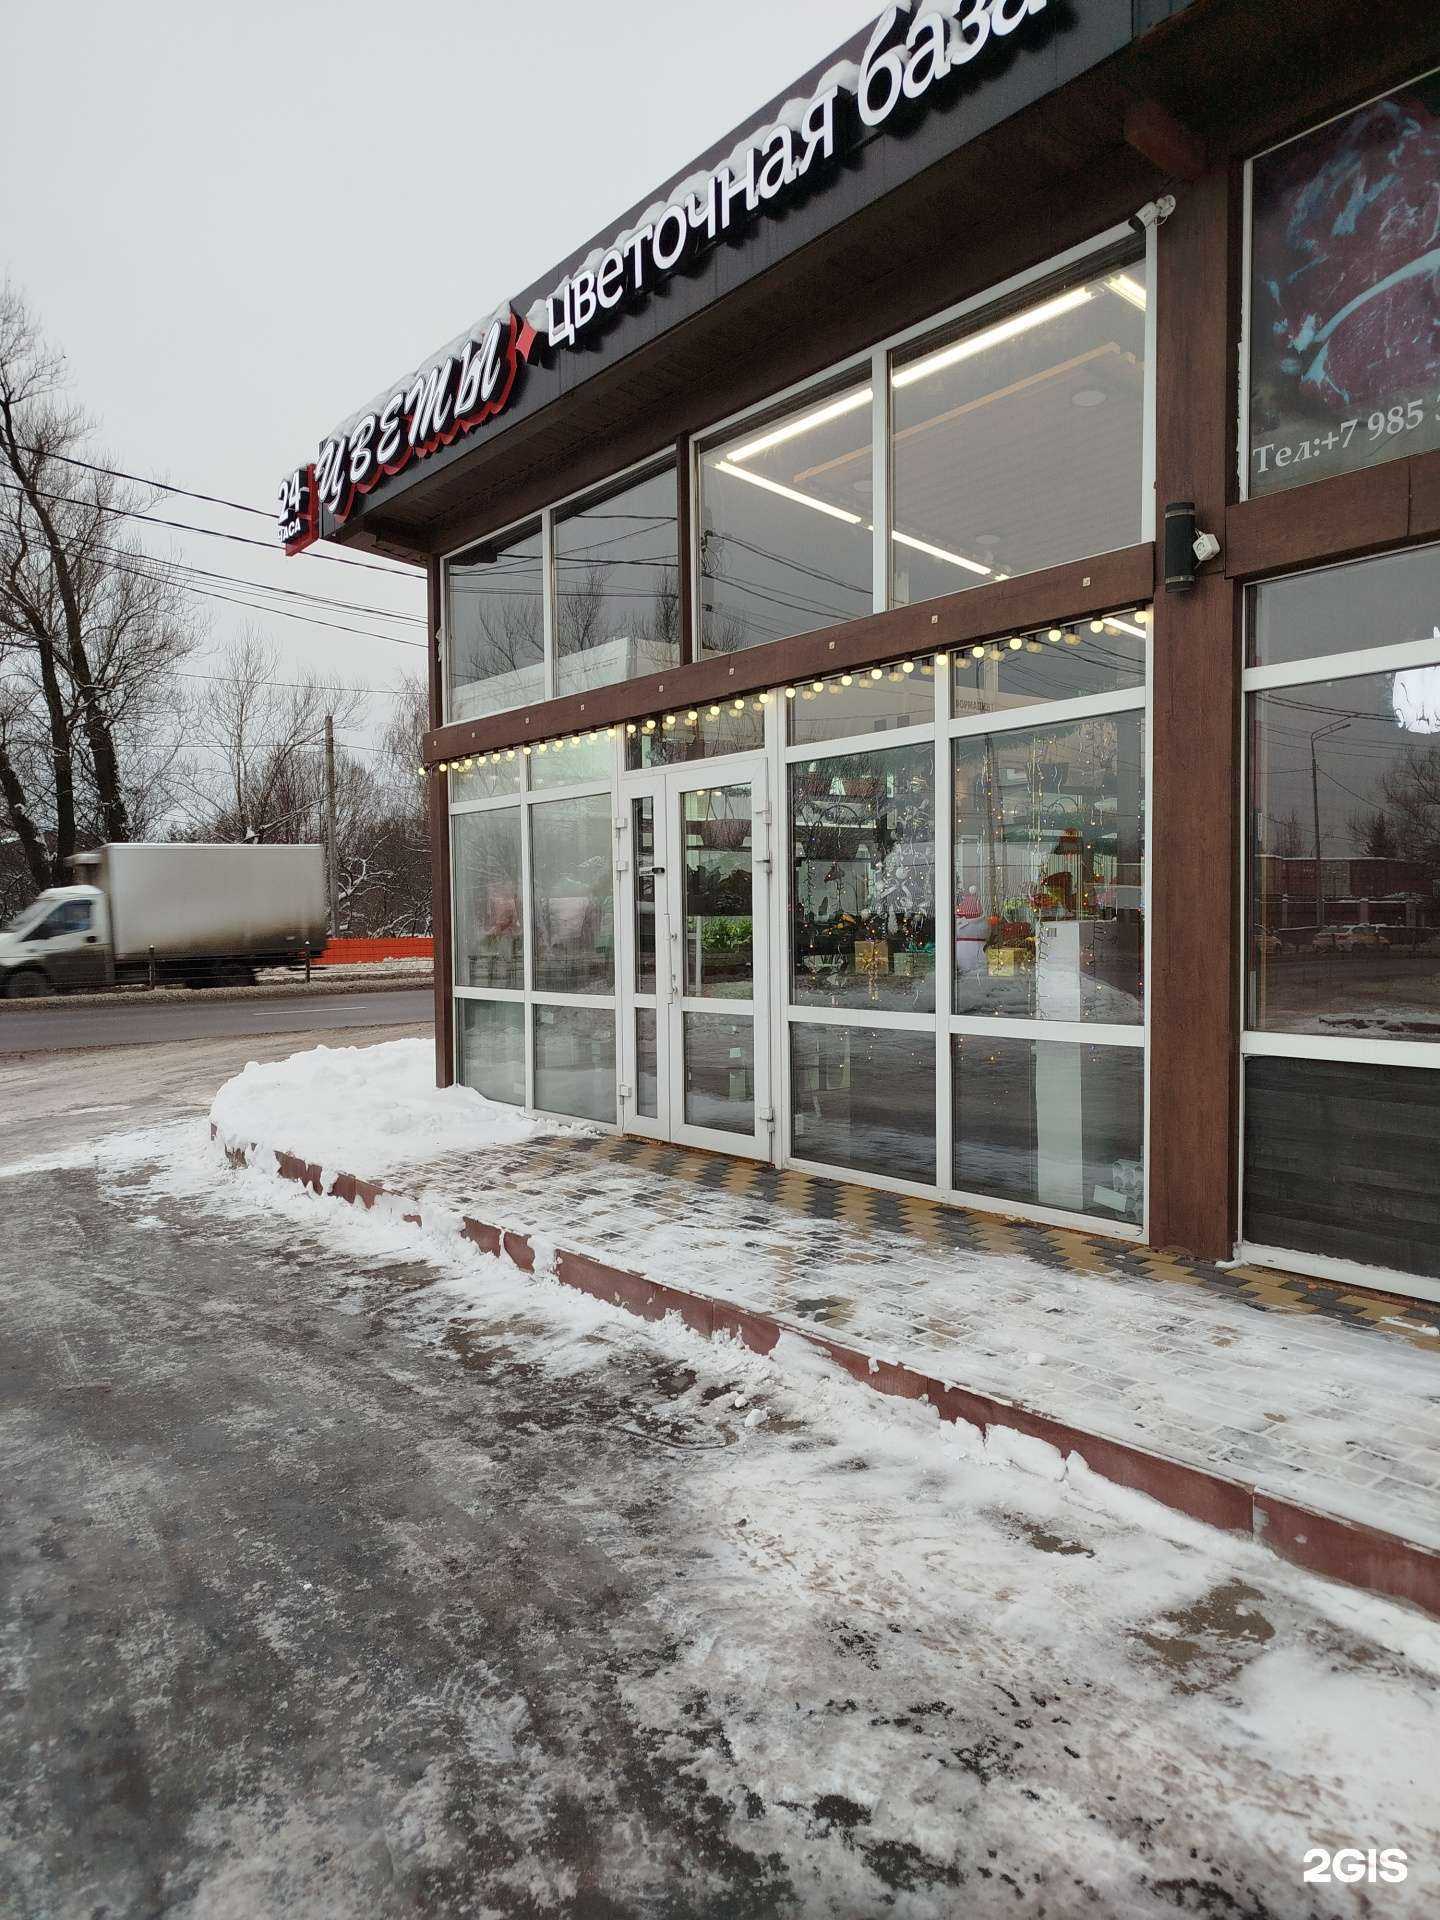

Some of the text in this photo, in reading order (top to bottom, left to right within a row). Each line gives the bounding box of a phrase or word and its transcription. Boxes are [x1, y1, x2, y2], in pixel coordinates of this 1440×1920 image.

[546, 84, 838, 348] цветочная
[1367, 400, 1424, 441] 985
[278, 470, 301, 525] 24
